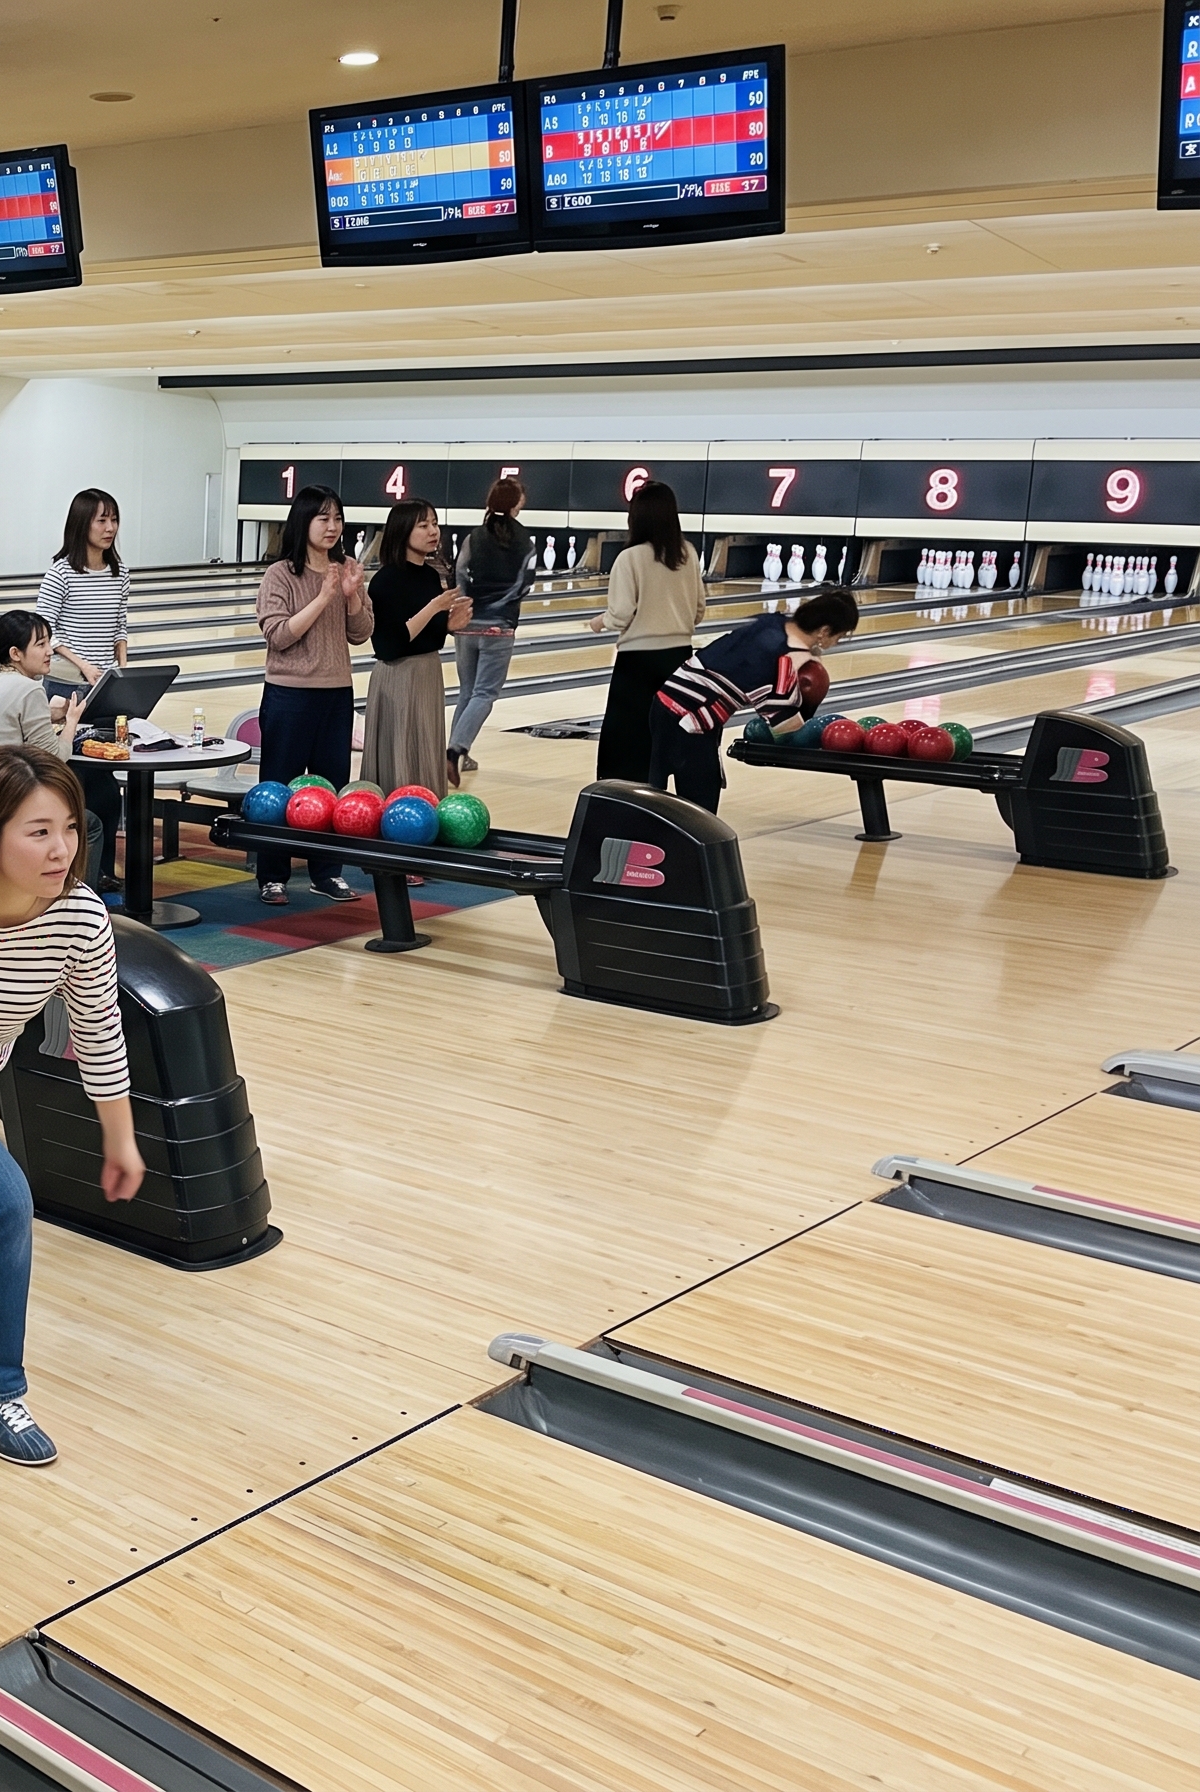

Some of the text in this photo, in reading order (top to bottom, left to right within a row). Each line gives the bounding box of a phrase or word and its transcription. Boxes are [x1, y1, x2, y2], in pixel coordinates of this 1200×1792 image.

[748, 121, 764, 136] 80
[750, 152, 764, 166] 20
[282, 466, 1141, 514] 1 4 6 7 8 9
